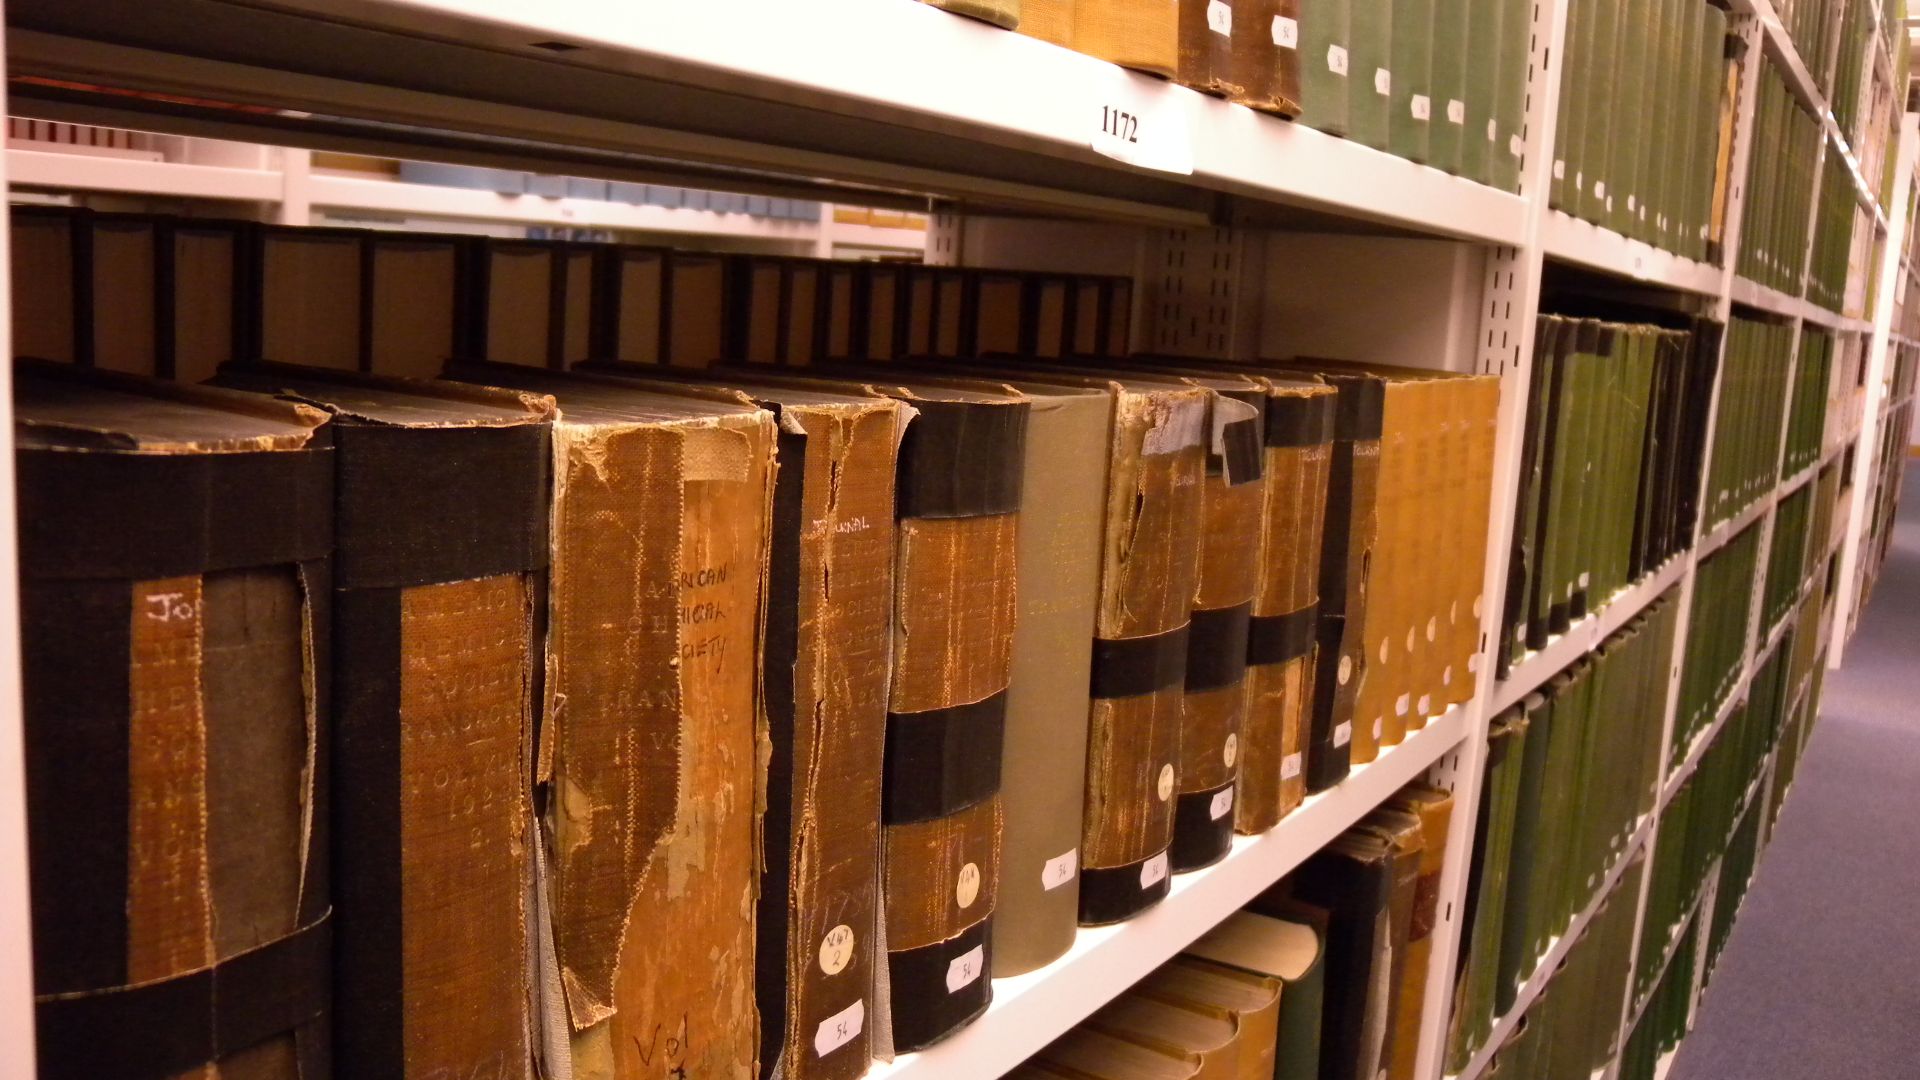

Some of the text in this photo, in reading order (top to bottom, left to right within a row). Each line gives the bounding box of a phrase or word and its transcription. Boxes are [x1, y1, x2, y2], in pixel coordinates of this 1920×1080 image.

[1102, 105, 1138, 143] 1172
[832, 951, 841, 967] 2
[632, 1012, 689, 1067] Vol
